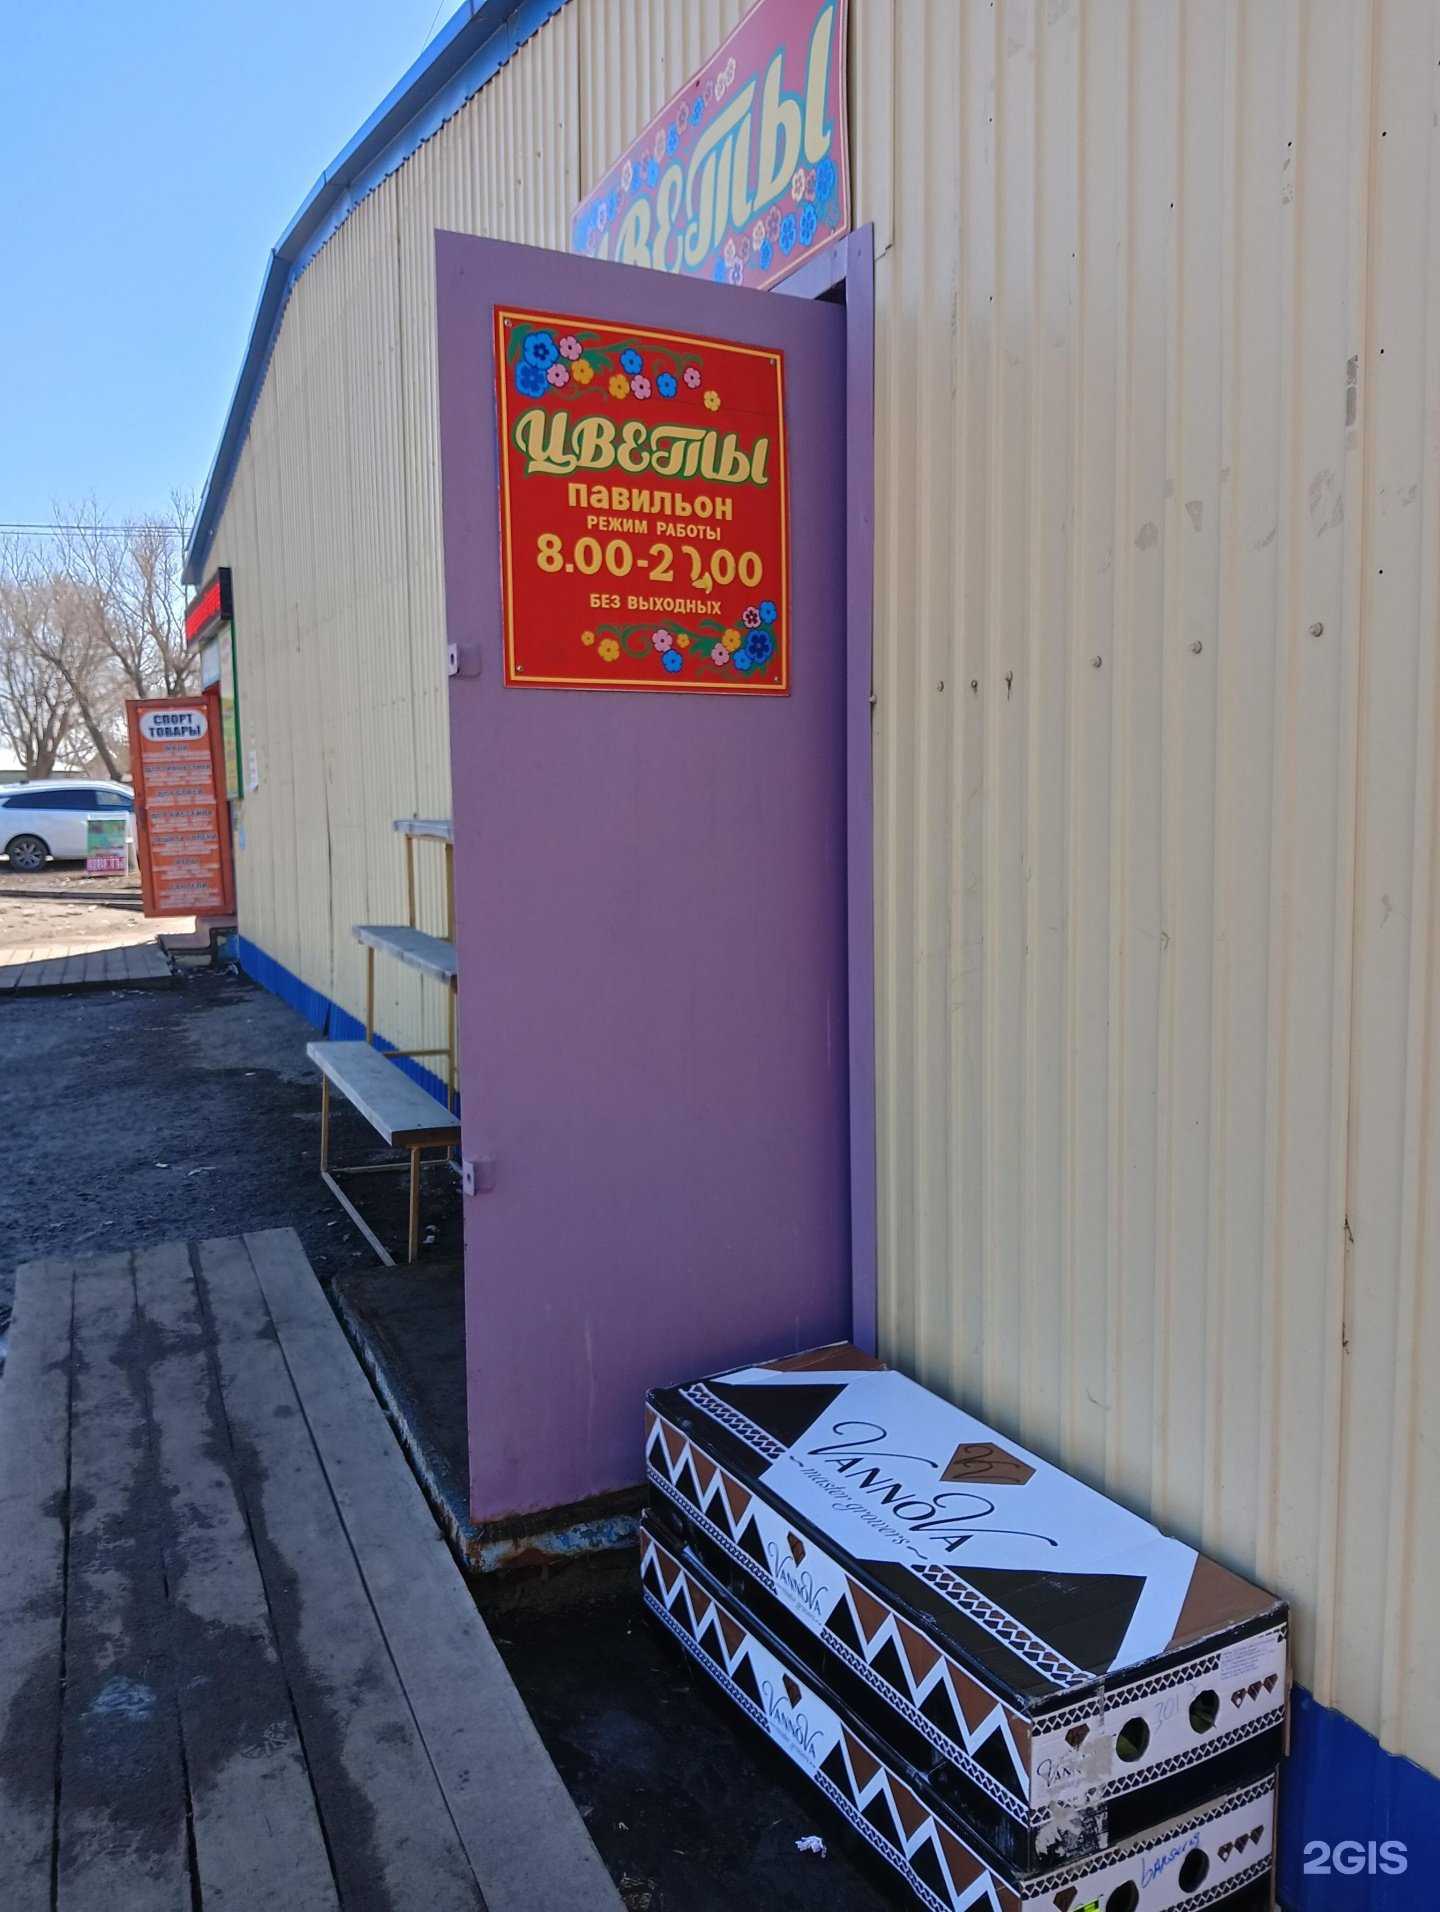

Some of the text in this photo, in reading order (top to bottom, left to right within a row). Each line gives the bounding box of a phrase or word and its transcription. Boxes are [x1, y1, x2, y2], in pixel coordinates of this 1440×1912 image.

[591, 4, 834, 274] ВЕТЫ
[514, 408, 769, 485] ЦВЕТЫ
[587, 515, 721, 541] РЕЖИМ РАБОТЫ
[589, 593, 722, 615] БЕЗ ВЫХОДНЫХ
[149, 725, 201, 737] ТОВАРЫ
[153, 713, 193, 725] СПОРТ
[799, 1467, 852, 1501] master
[831, 1502, 911, 1546] growers
